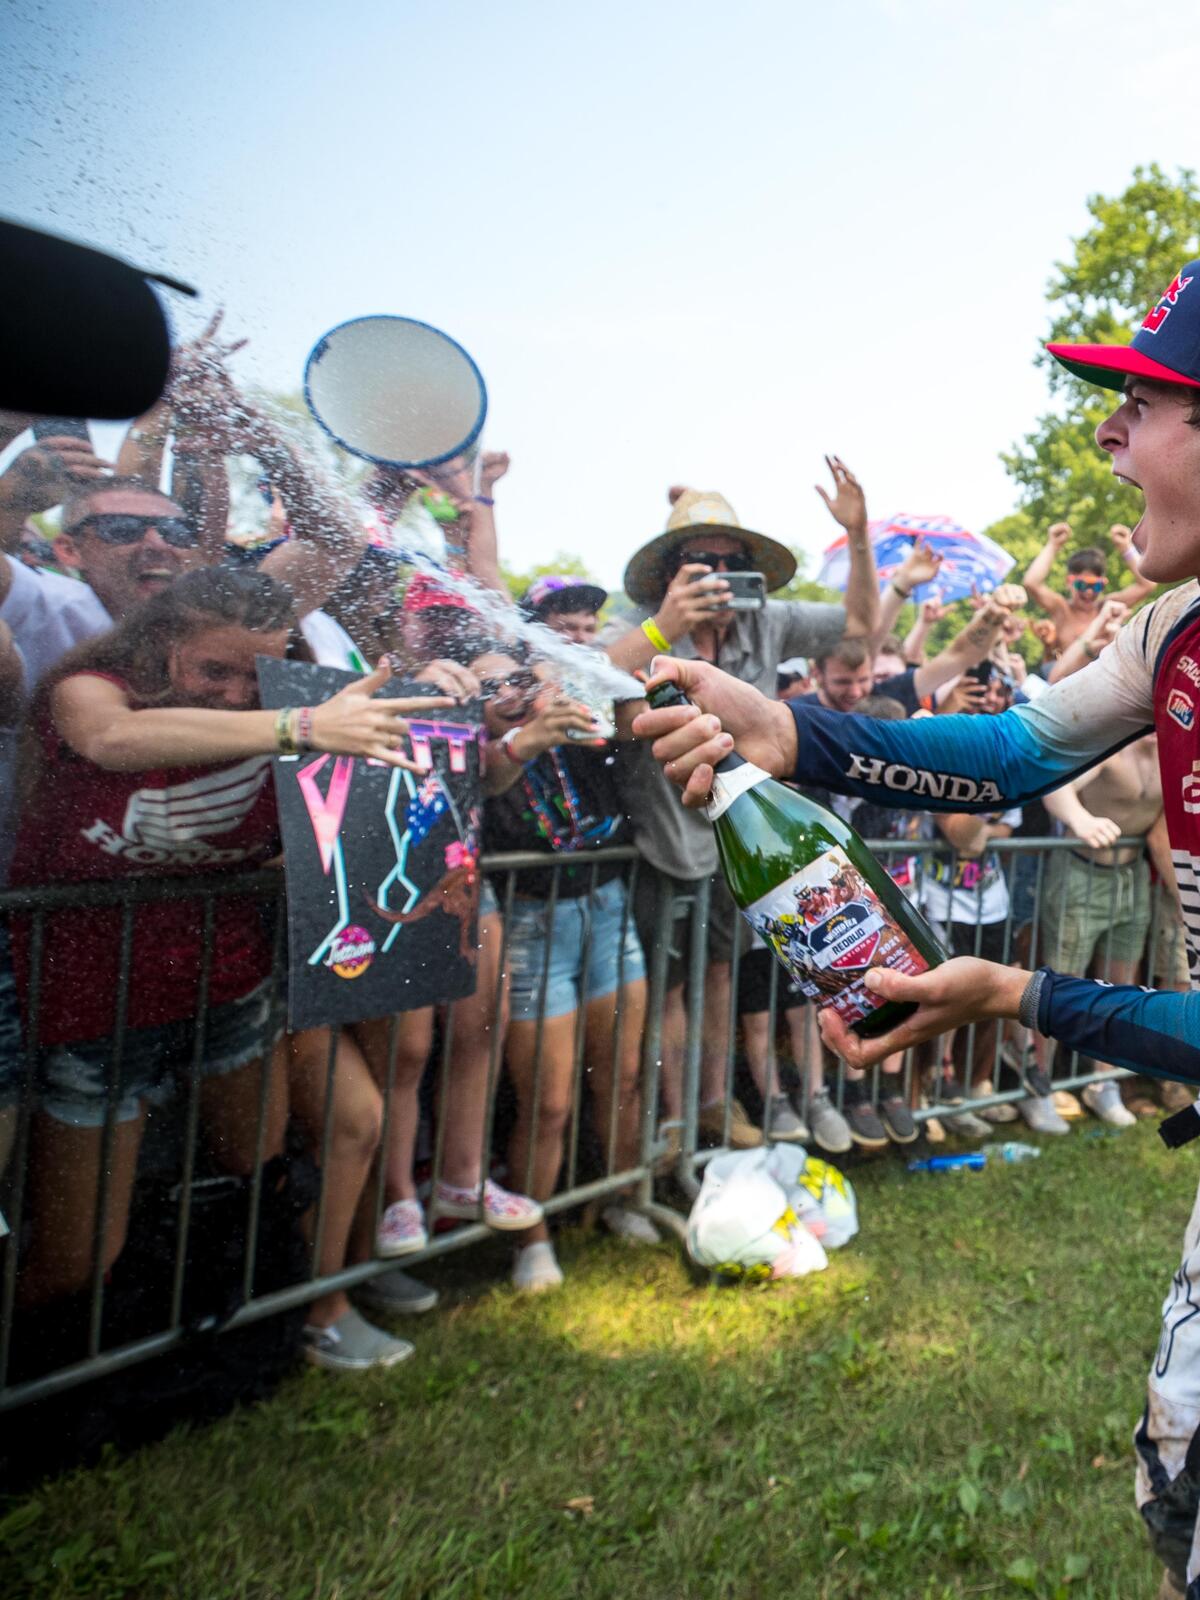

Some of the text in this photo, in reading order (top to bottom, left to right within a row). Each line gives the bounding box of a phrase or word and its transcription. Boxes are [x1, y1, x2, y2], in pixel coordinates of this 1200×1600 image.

[846, 753, 1003, 802] HONDA
[836, 935, 876, 965] NATIONAL
[879, 935, 900, 955] 2021
